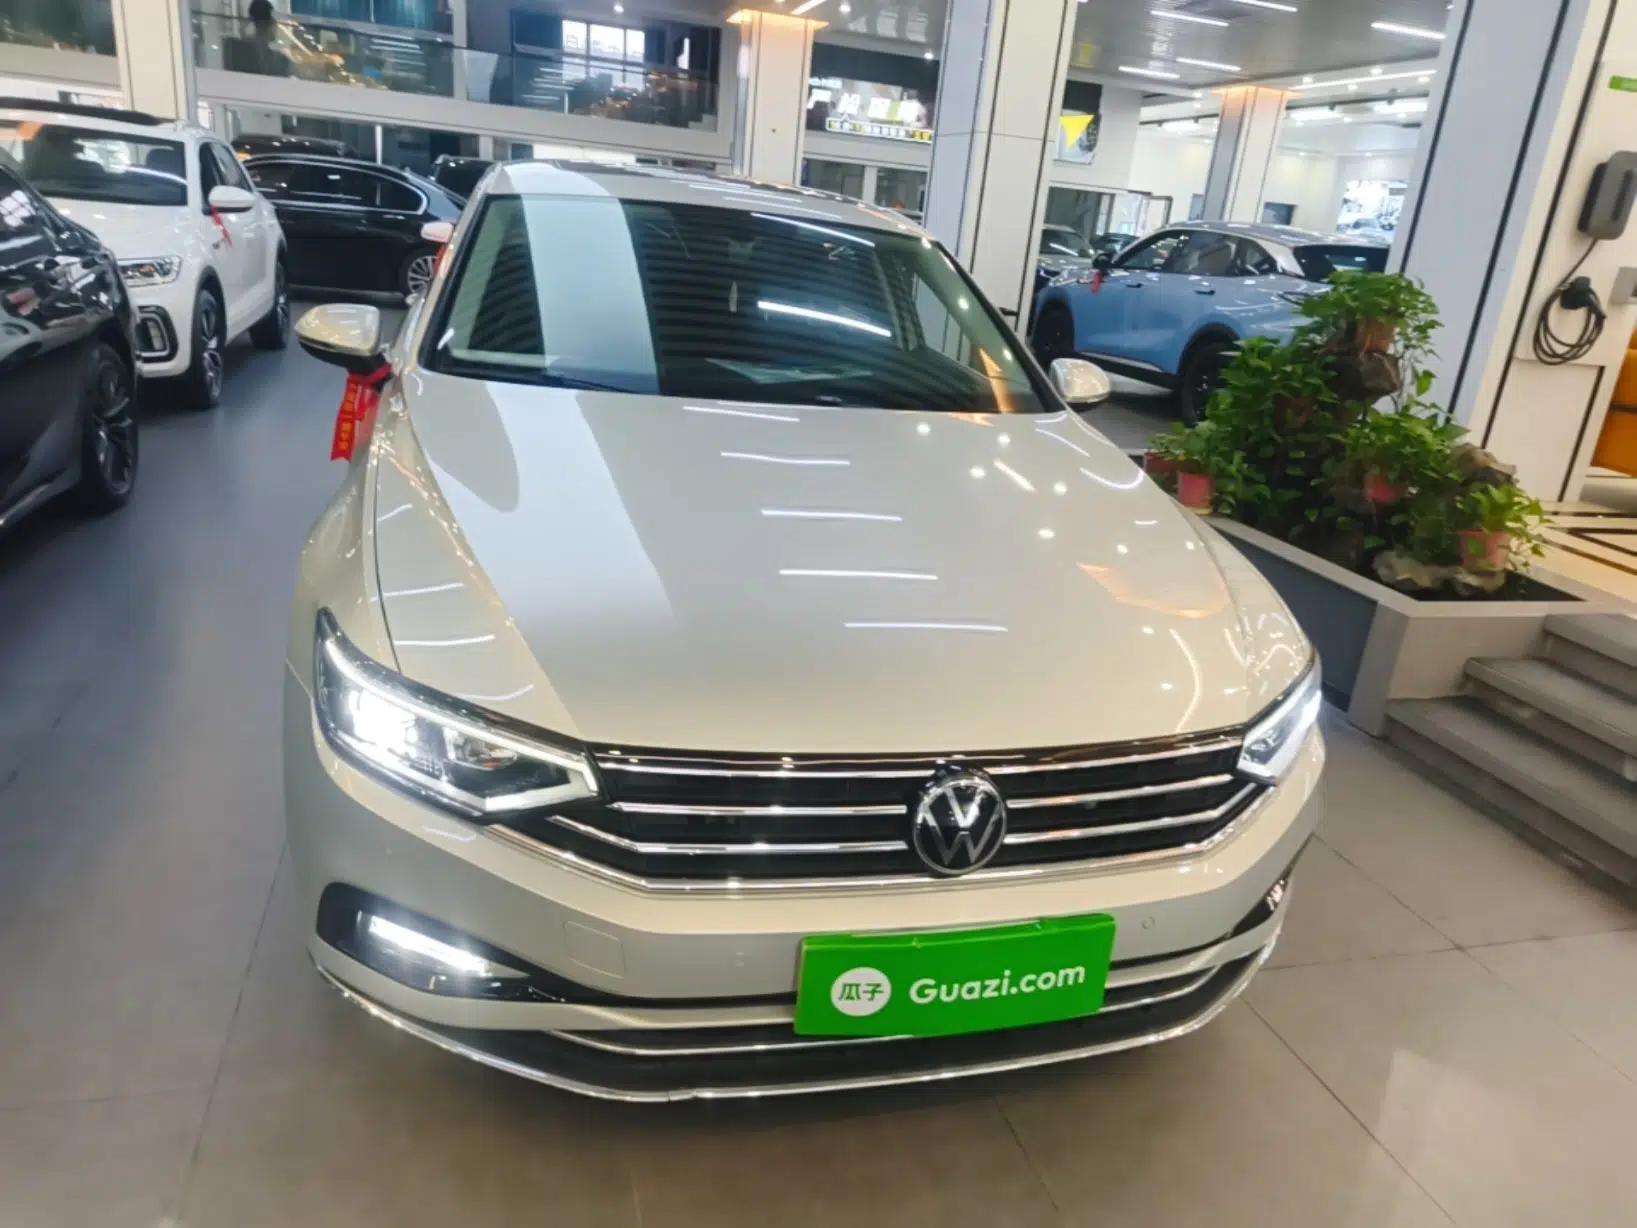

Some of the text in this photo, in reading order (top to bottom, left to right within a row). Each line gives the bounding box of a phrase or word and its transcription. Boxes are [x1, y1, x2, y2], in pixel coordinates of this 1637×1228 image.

[918, 779, 1003, 867] VW
[839, 982, 885, 1002] 瓜子
[909, 965, 1086, 1004] Guazi.com
